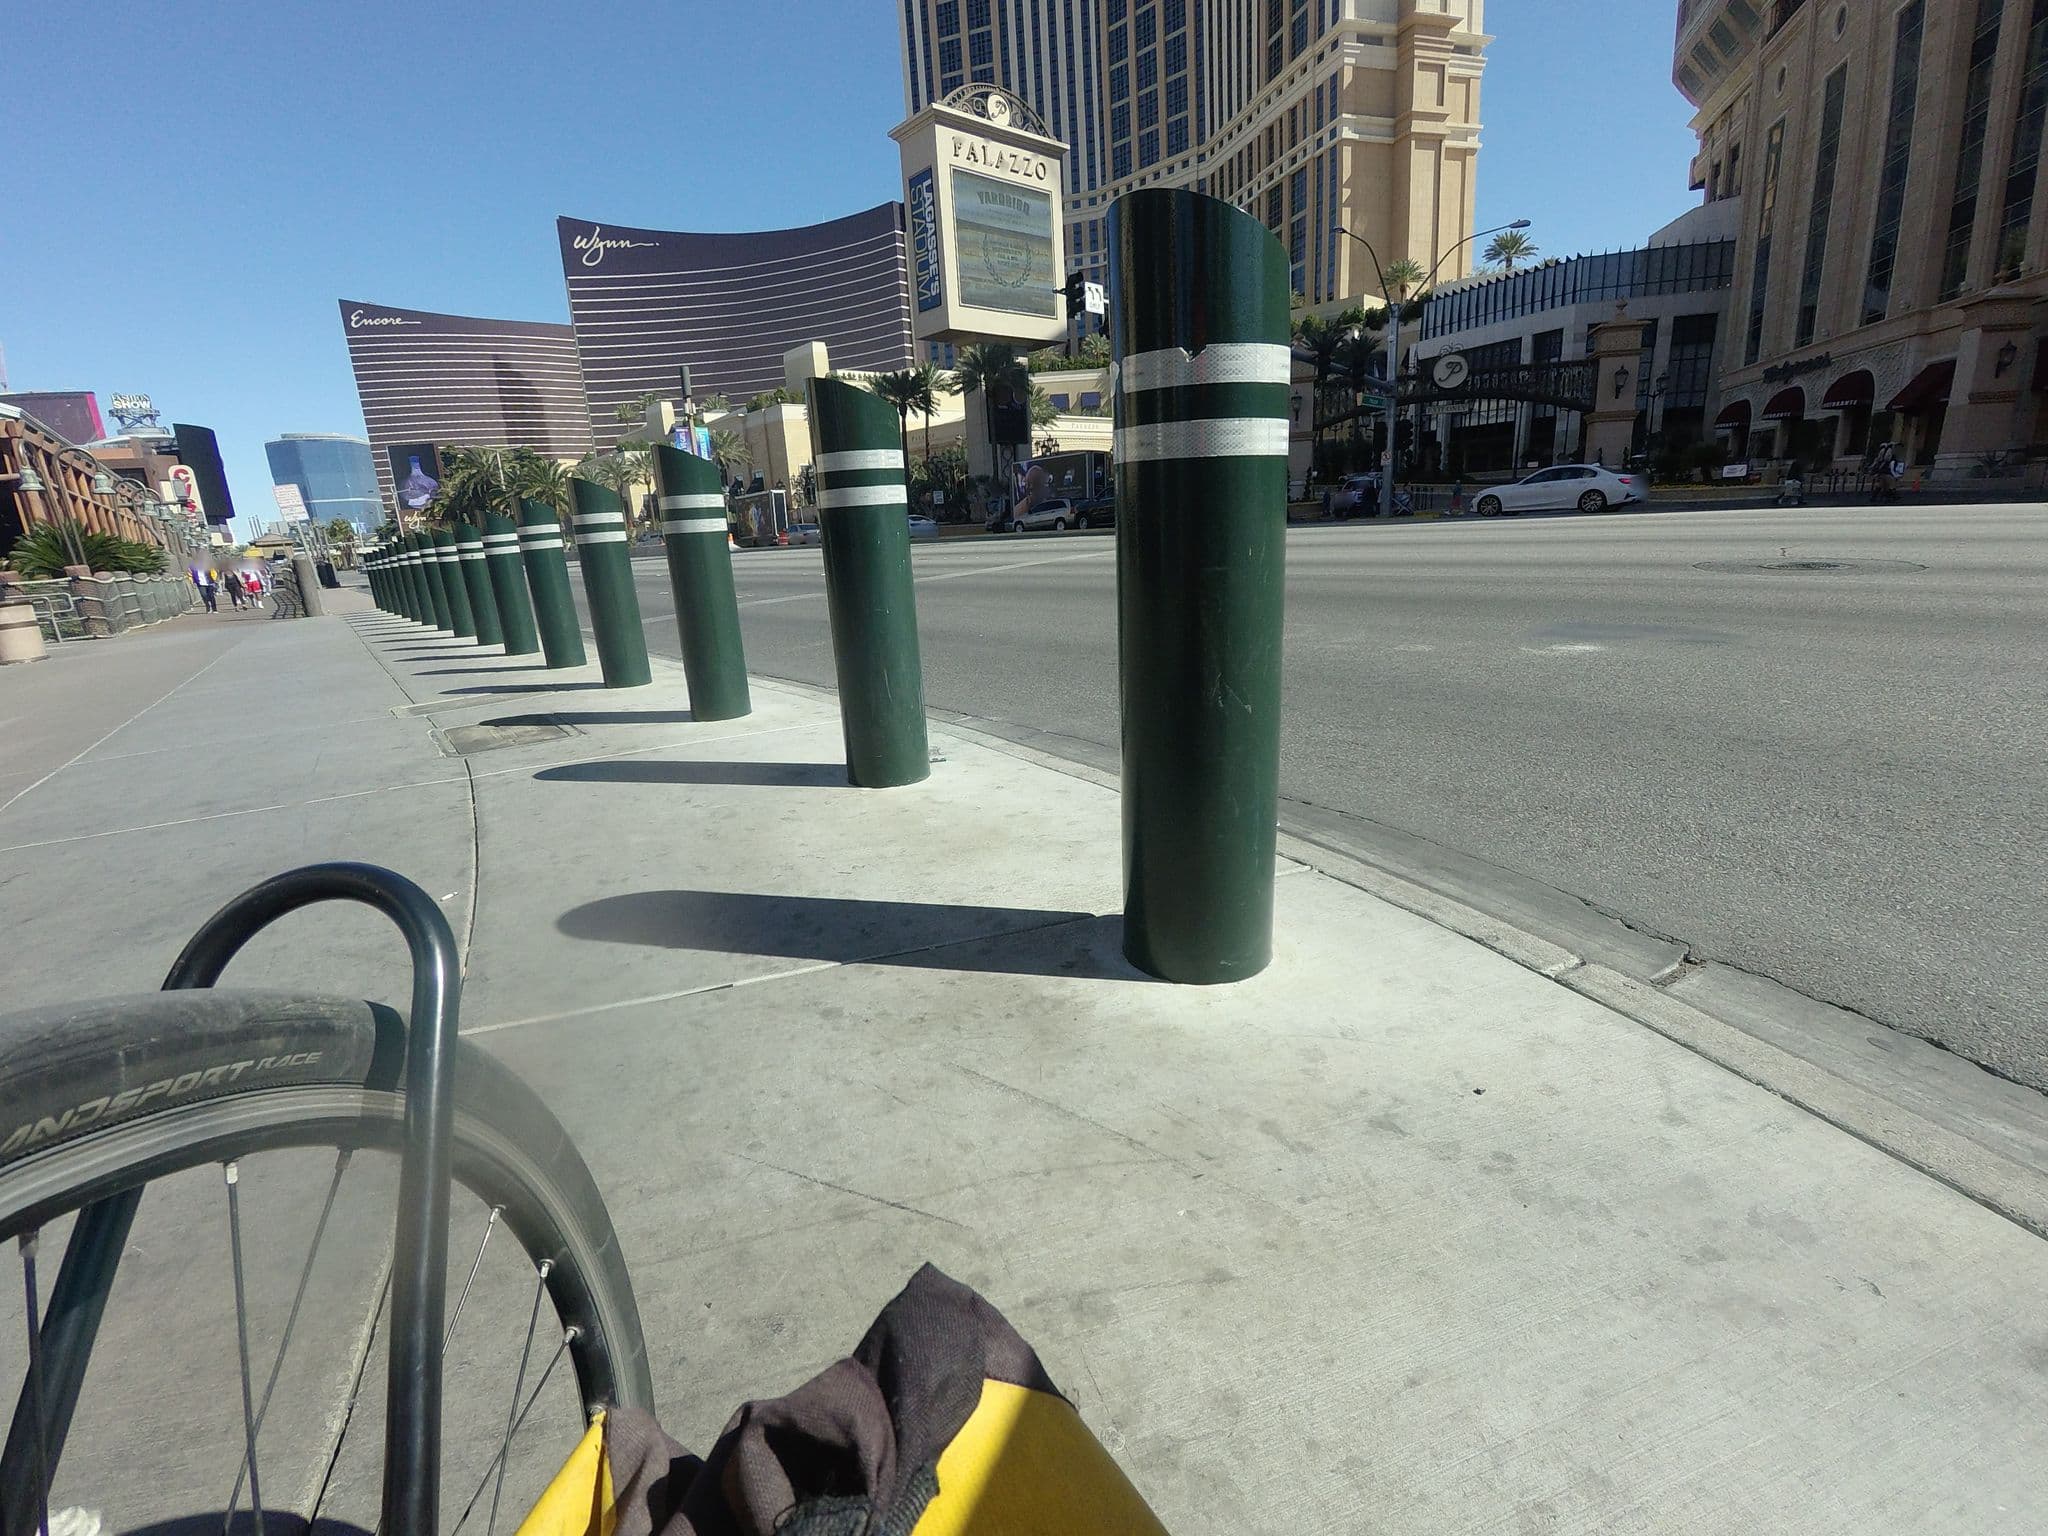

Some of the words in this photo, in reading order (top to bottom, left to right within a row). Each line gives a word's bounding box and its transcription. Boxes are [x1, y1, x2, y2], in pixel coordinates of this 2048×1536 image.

[952, 136, 1047, 181] PALAZZO
[573, 226, 655, 266] Wynn
[910, 187, 932, 301] STADIUM
[922, 178, 940, 296] LAGASSE'S
[350, 309, 421, 329] Encore
[112, 400, 150, 409] SHOW
[256, 1051, 323, 1070] RACE
